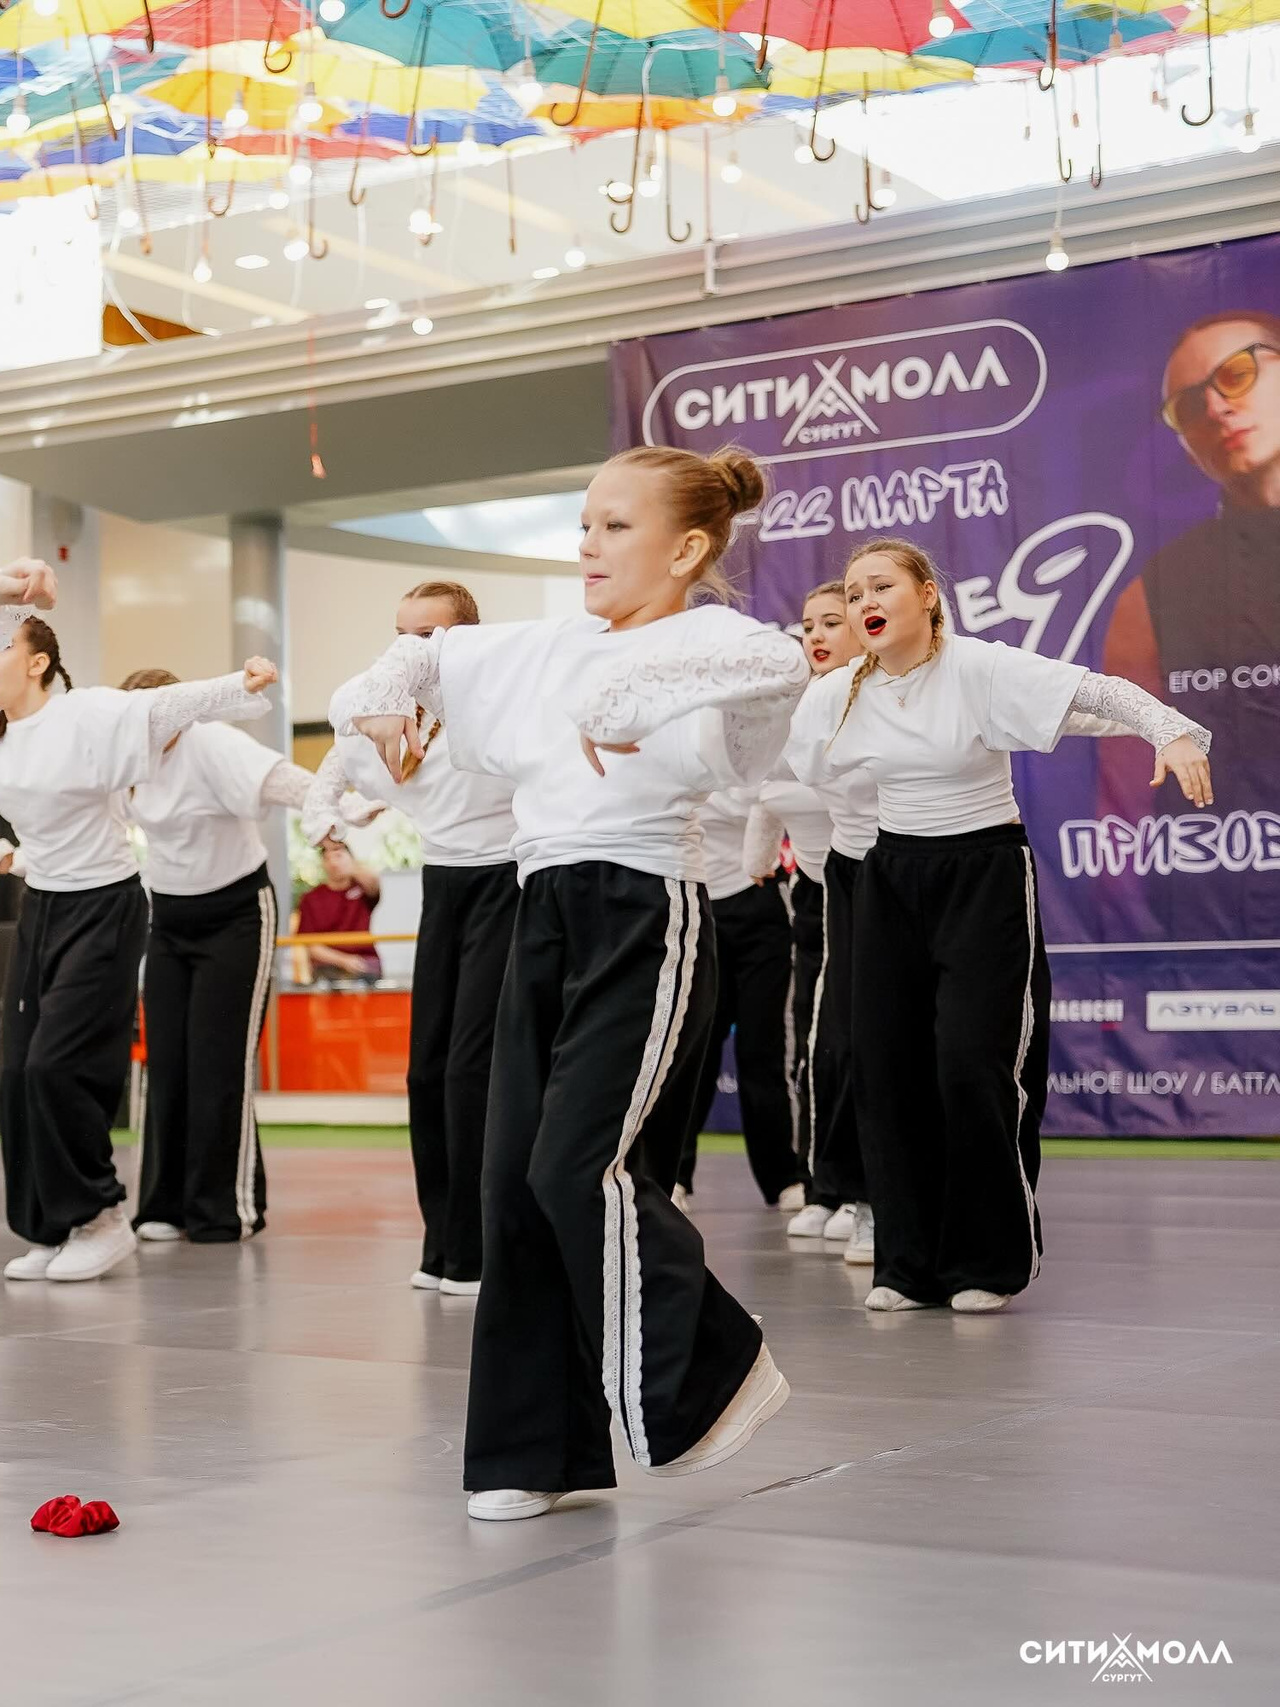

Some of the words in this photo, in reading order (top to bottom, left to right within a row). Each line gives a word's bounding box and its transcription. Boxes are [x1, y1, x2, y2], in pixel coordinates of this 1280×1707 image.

[840, 458, 1009, 533] МАРТА
[1168, 667, 1228, 694] ЕГОР
[1126, 1070, 1188, 1095] ШОУ
